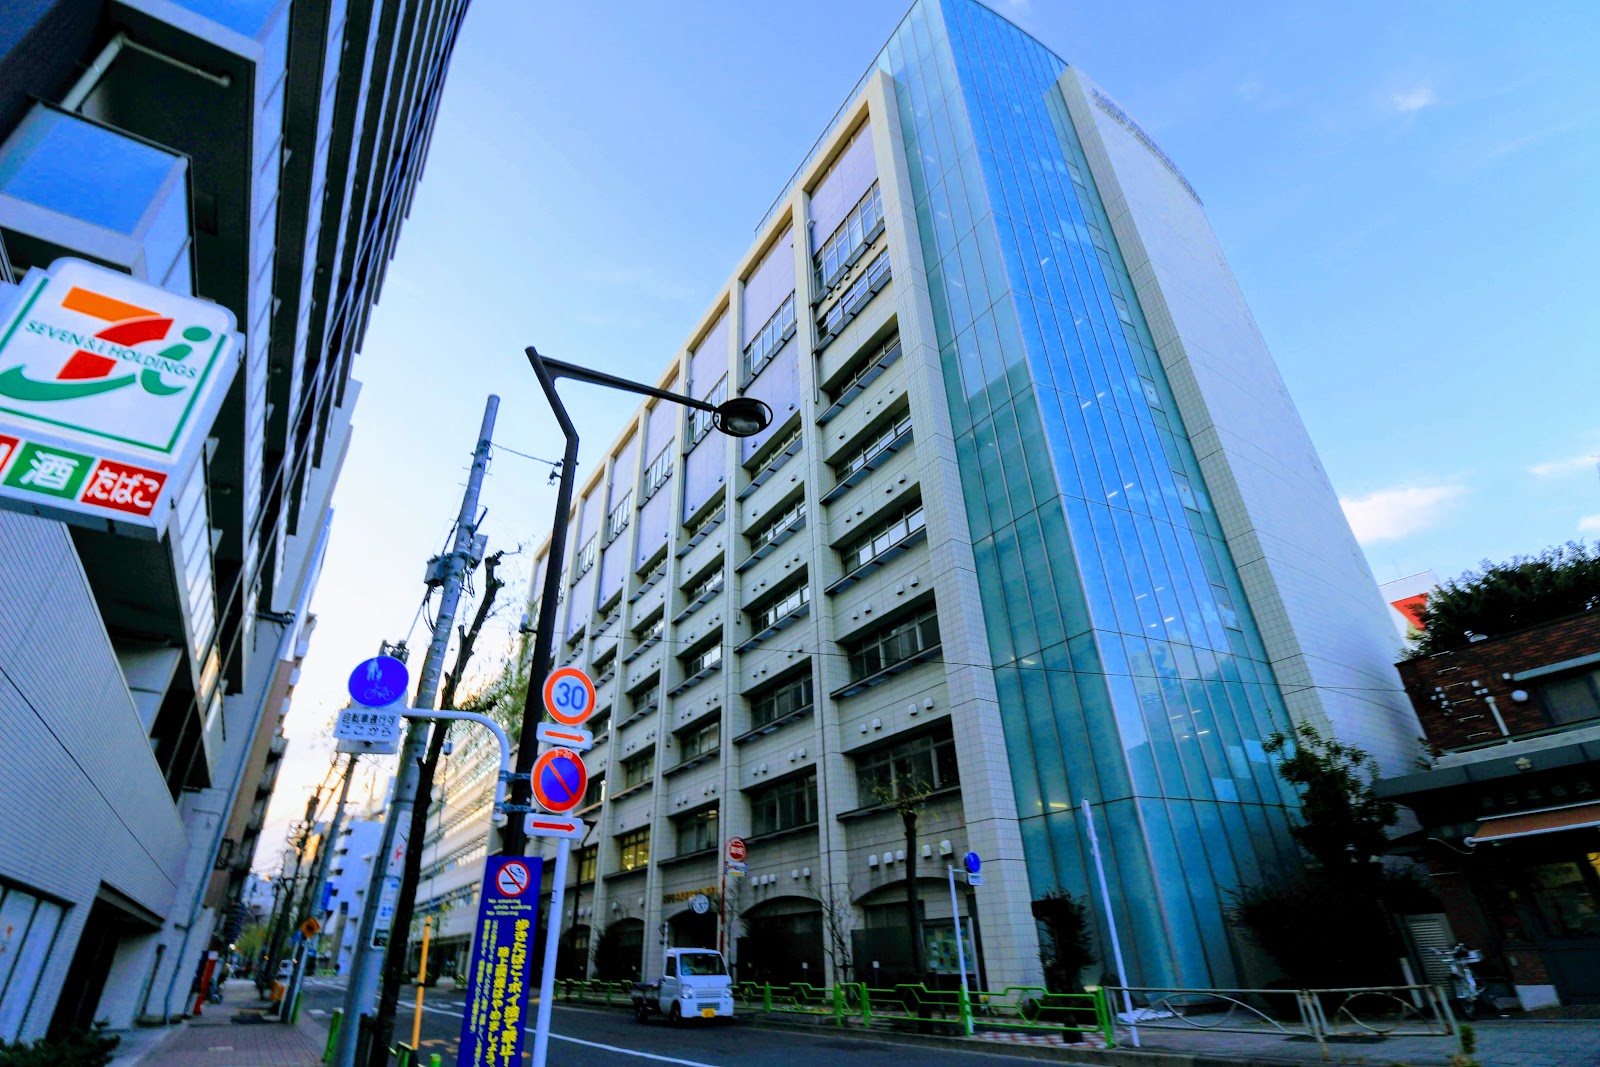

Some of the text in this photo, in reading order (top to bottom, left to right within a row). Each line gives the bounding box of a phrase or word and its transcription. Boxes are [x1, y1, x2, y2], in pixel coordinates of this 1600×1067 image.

[108, 344, 197, 379] HOLDINGS
[19, 450, 80, 491] 酒
[87, 466, 160, 508] たばこ
[556, 682, 585, 710] 30
[340, 724, 391, 737] ここから
